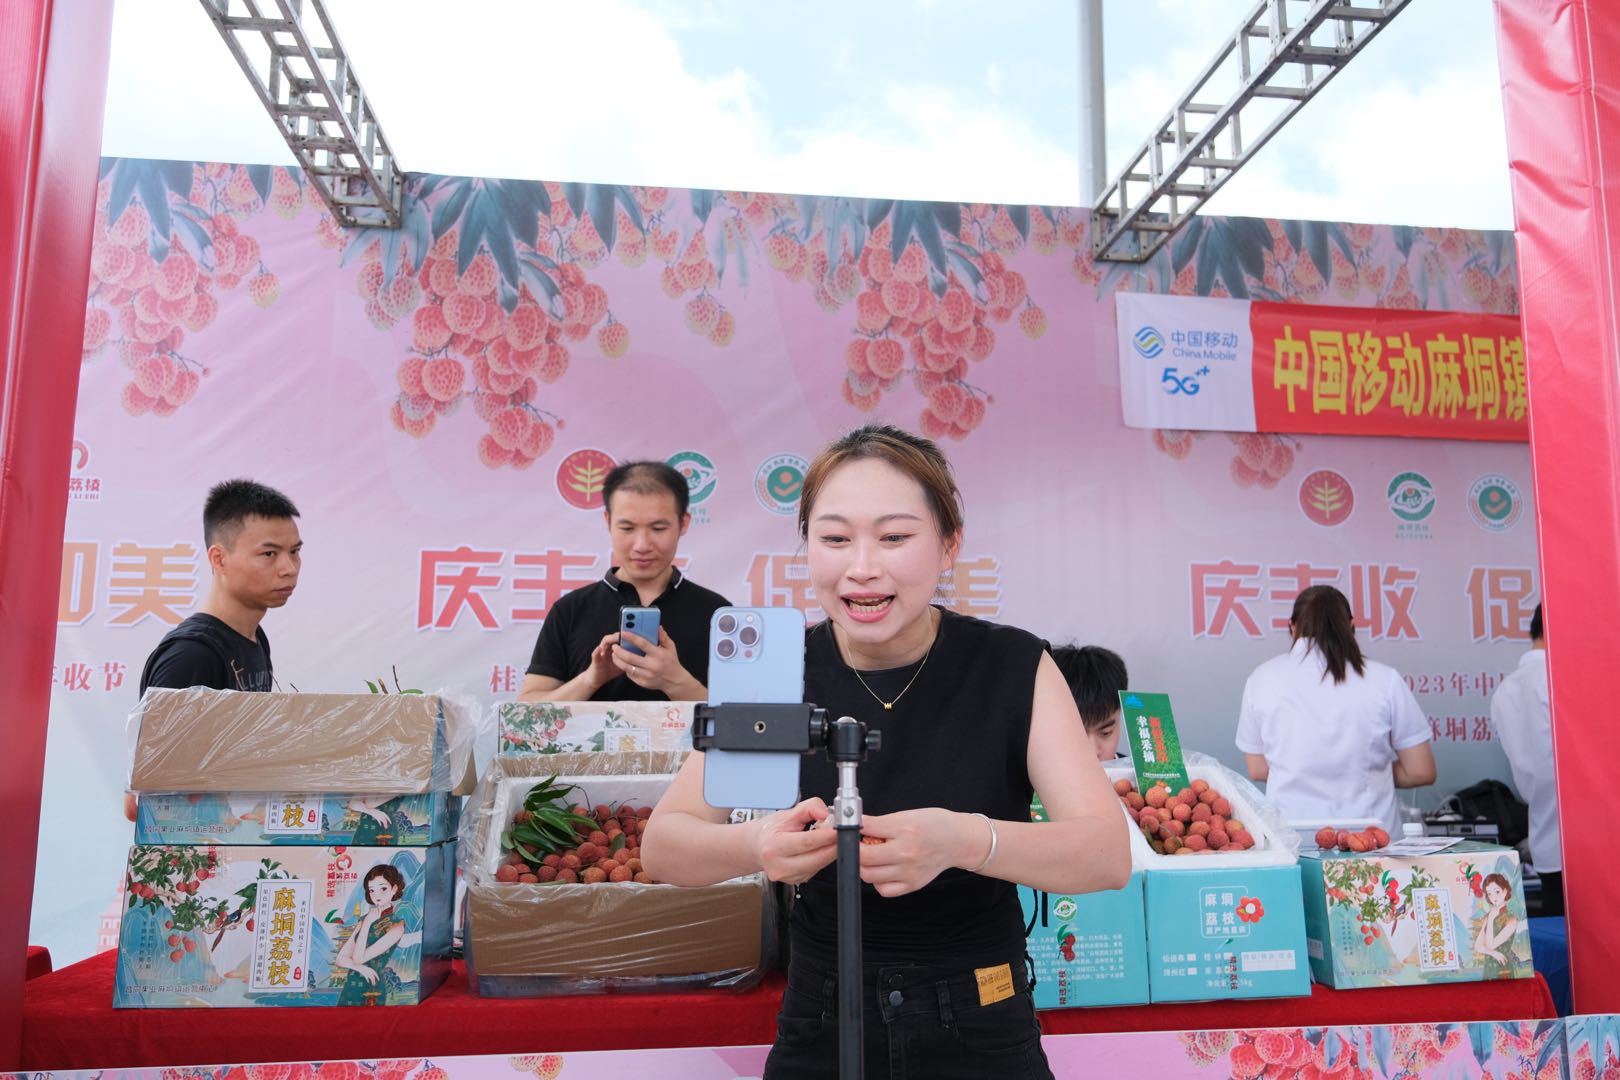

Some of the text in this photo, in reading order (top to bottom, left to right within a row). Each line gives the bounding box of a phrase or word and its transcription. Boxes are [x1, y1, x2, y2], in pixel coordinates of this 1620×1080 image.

[1171, 330, 1238, 348] 中国移动
[1172, 347, 1237, 361] China Mobile
[1273, 325, 1527, 421] 中国移动麻垌镇
[1189, 560, 1420, 640] 庆丰收
[52, 662, 126, 692] 收节
[1403, 671, 1504, 697] 023年中
[1205, 893, 1233, 906] 麻垌
[1206, 912, 1234, 926] 荔枝
[1424, 894, 1447, 966] 麻垌荔枝
[268, 887, 296, 985] 麻垌荔枝
